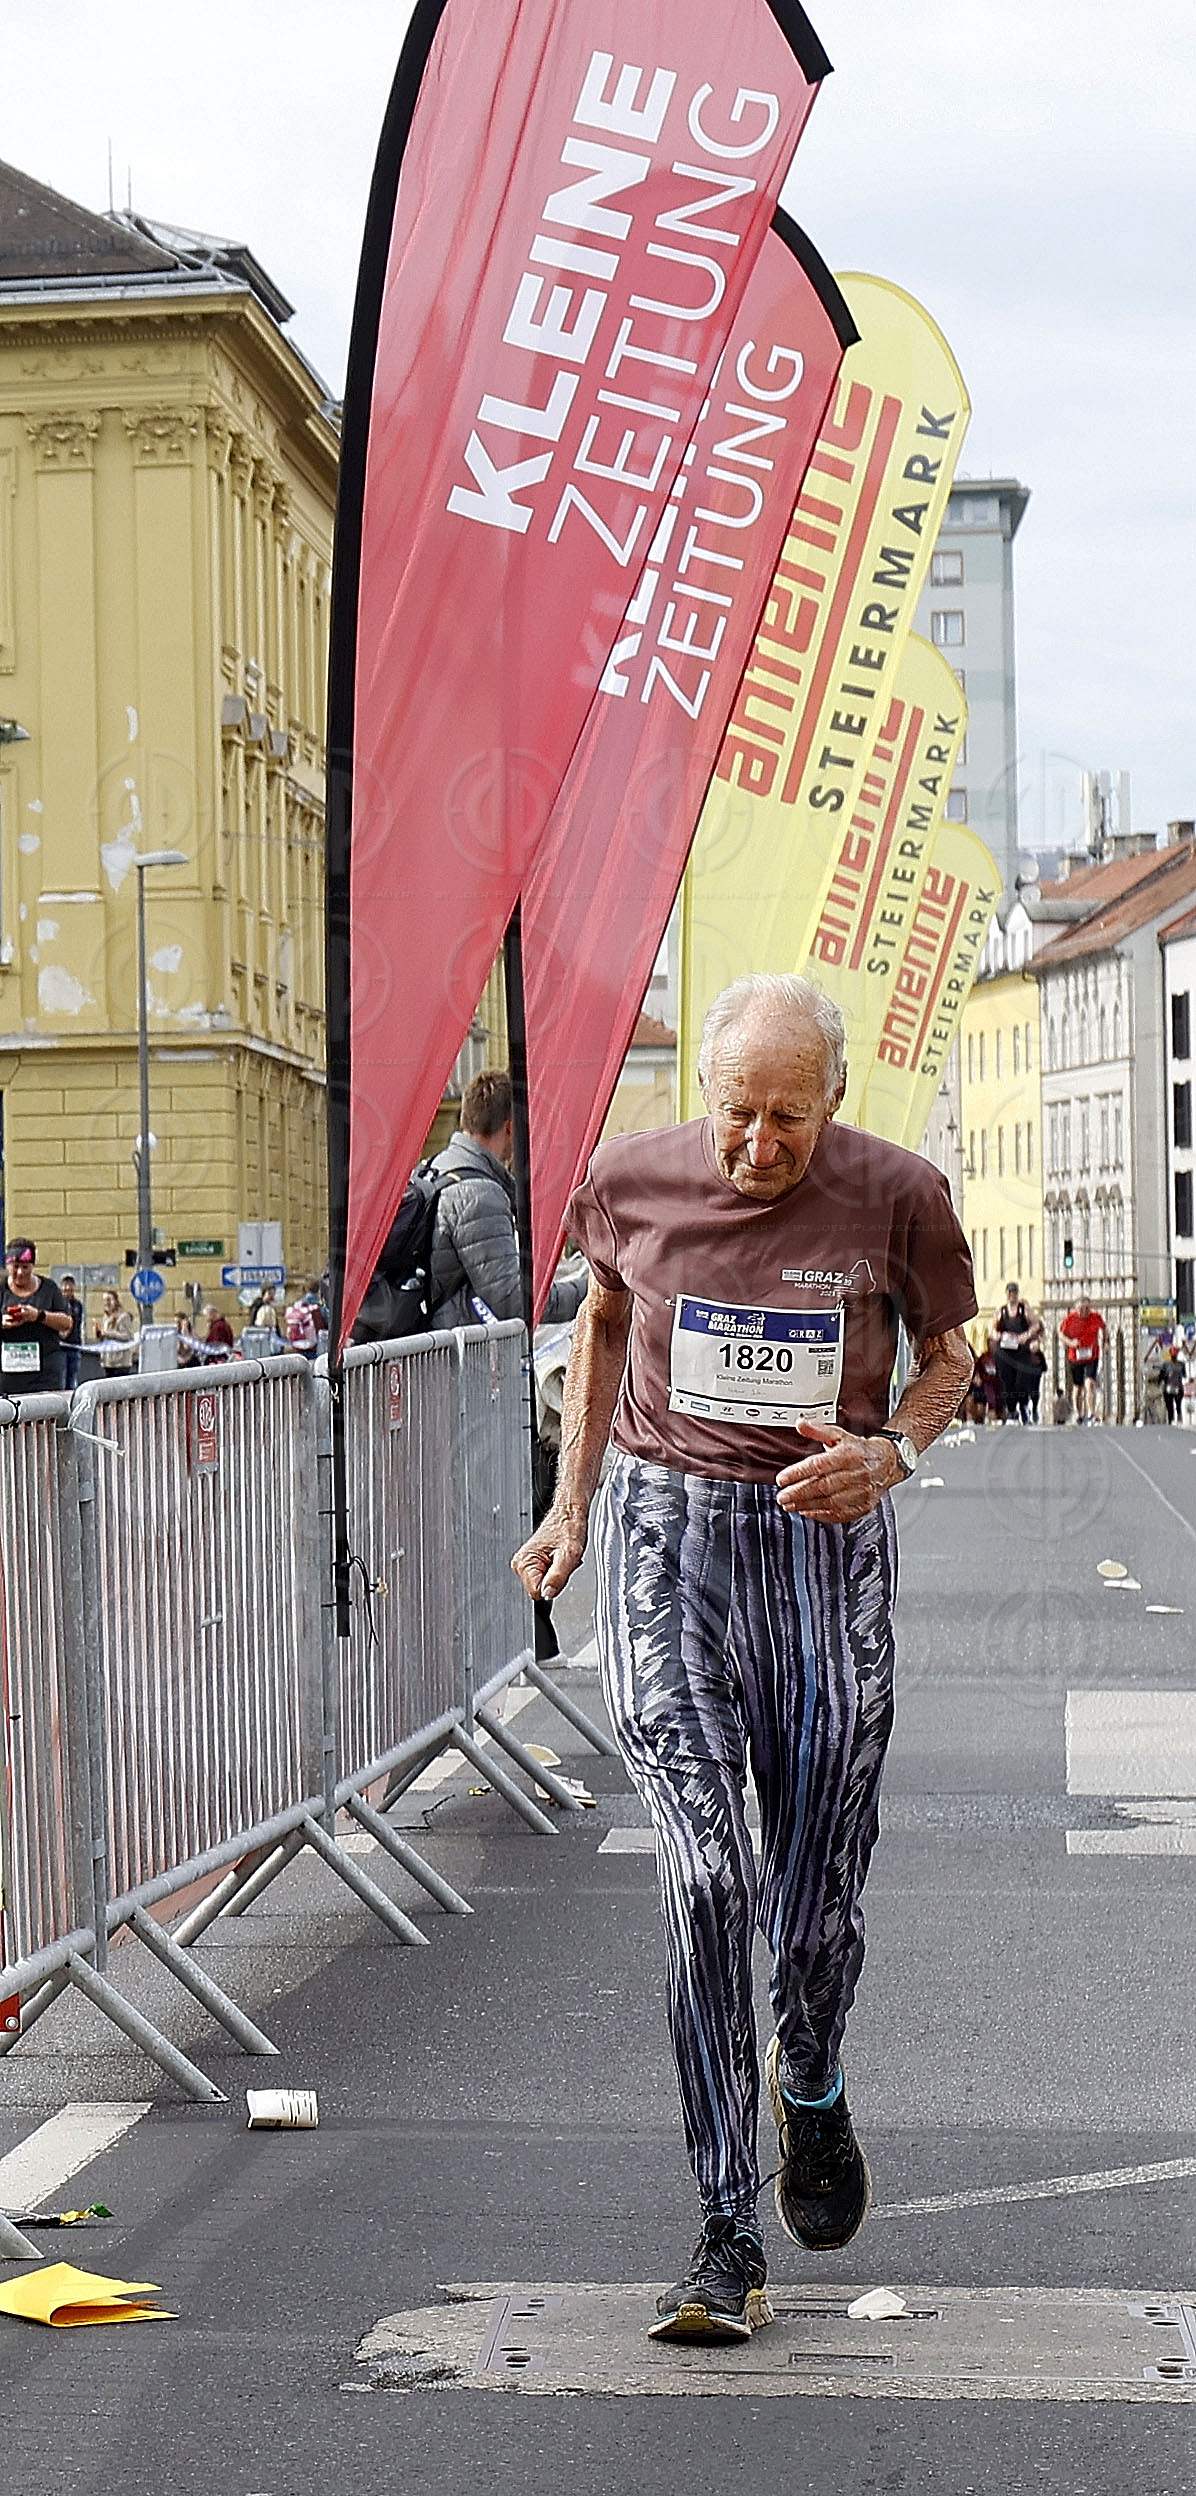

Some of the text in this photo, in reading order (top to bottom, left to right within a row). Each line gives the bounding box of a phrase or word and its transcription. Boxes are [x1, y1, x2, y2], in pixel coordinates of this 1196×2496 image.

[446, 50, 677, 534] KLEINE
[547, 82, 780, 567] ZEITUNG
[641, 340, 804, 720] ZEITUNG
[810, 406, 955, 812] STEIERMARK
[867, 713, 959, 976] STEIERMARK
[877, 866, 956, 1069] antenne
[921, 886, 995, 1077] STEIERMARK
[708, 1320, 764, 1335] MARATHON
[711, 1312, 737, 1325] GRAZ
[719, 1343, 793, 1373] 1820
[804, 1270, 844, 1284] GRAZ
[737, 1375, 761, 1385] Zeitung
[762, 1377, 793, 1386] Marathon
